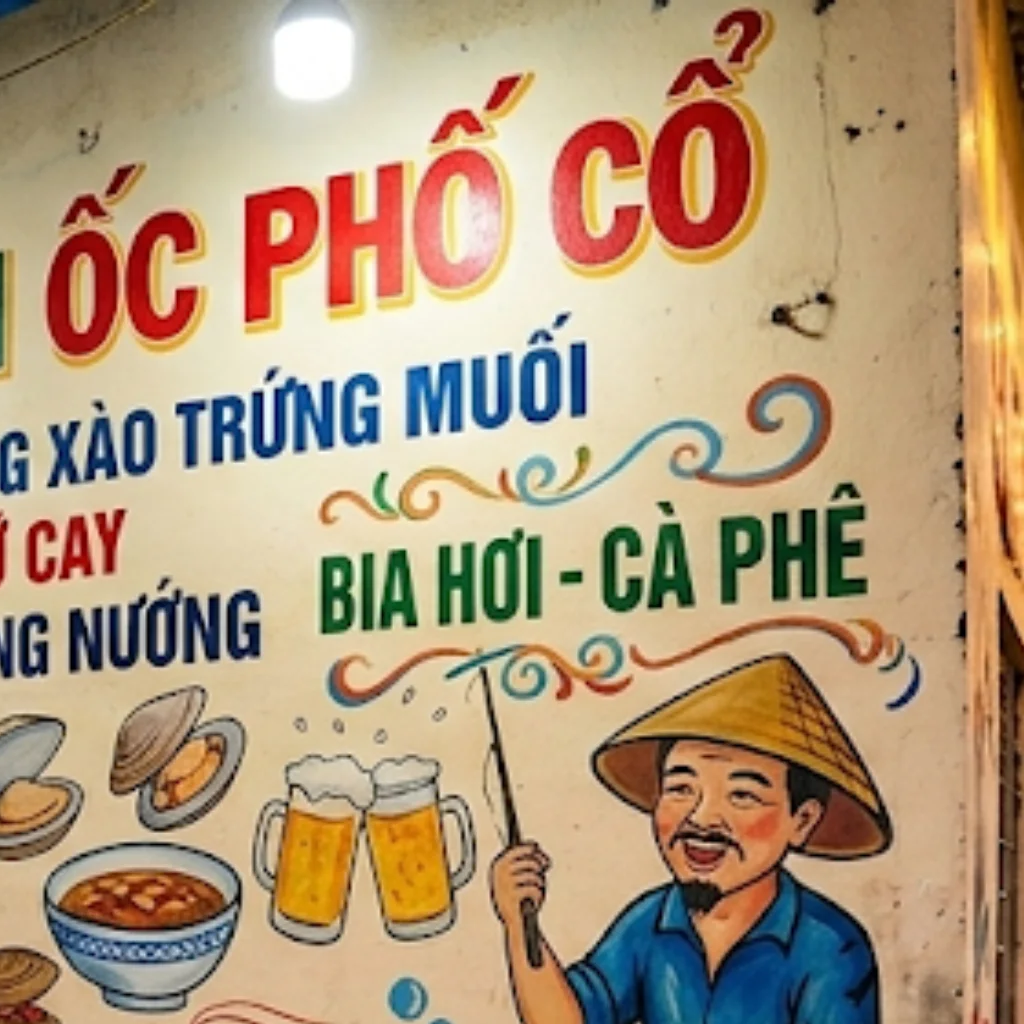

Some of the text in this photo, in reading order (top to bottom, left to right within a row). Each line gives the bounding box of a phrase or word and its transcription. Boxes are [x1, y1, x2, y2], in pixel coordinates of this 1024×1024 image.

[45, 162, 204, 364] ỐC
[244, 74, 532, 332] PHỐ
[551, 10, 772, 276] CỔ
[46, 400, 157, 488] XÀO
[176, 367, 381, 469] TRỨNG
[405, 311, 588, 439] MUỐI
[26, 508, 128, 585] CAY
[319, 551, 419, 634] BIA
[436, 526, 543, 626] HƠI
[600, 500, 696, 613] CÀ
[719, 482, 868, 605] PHÊ
[68, 577, 262, 674] NƯỚNG
